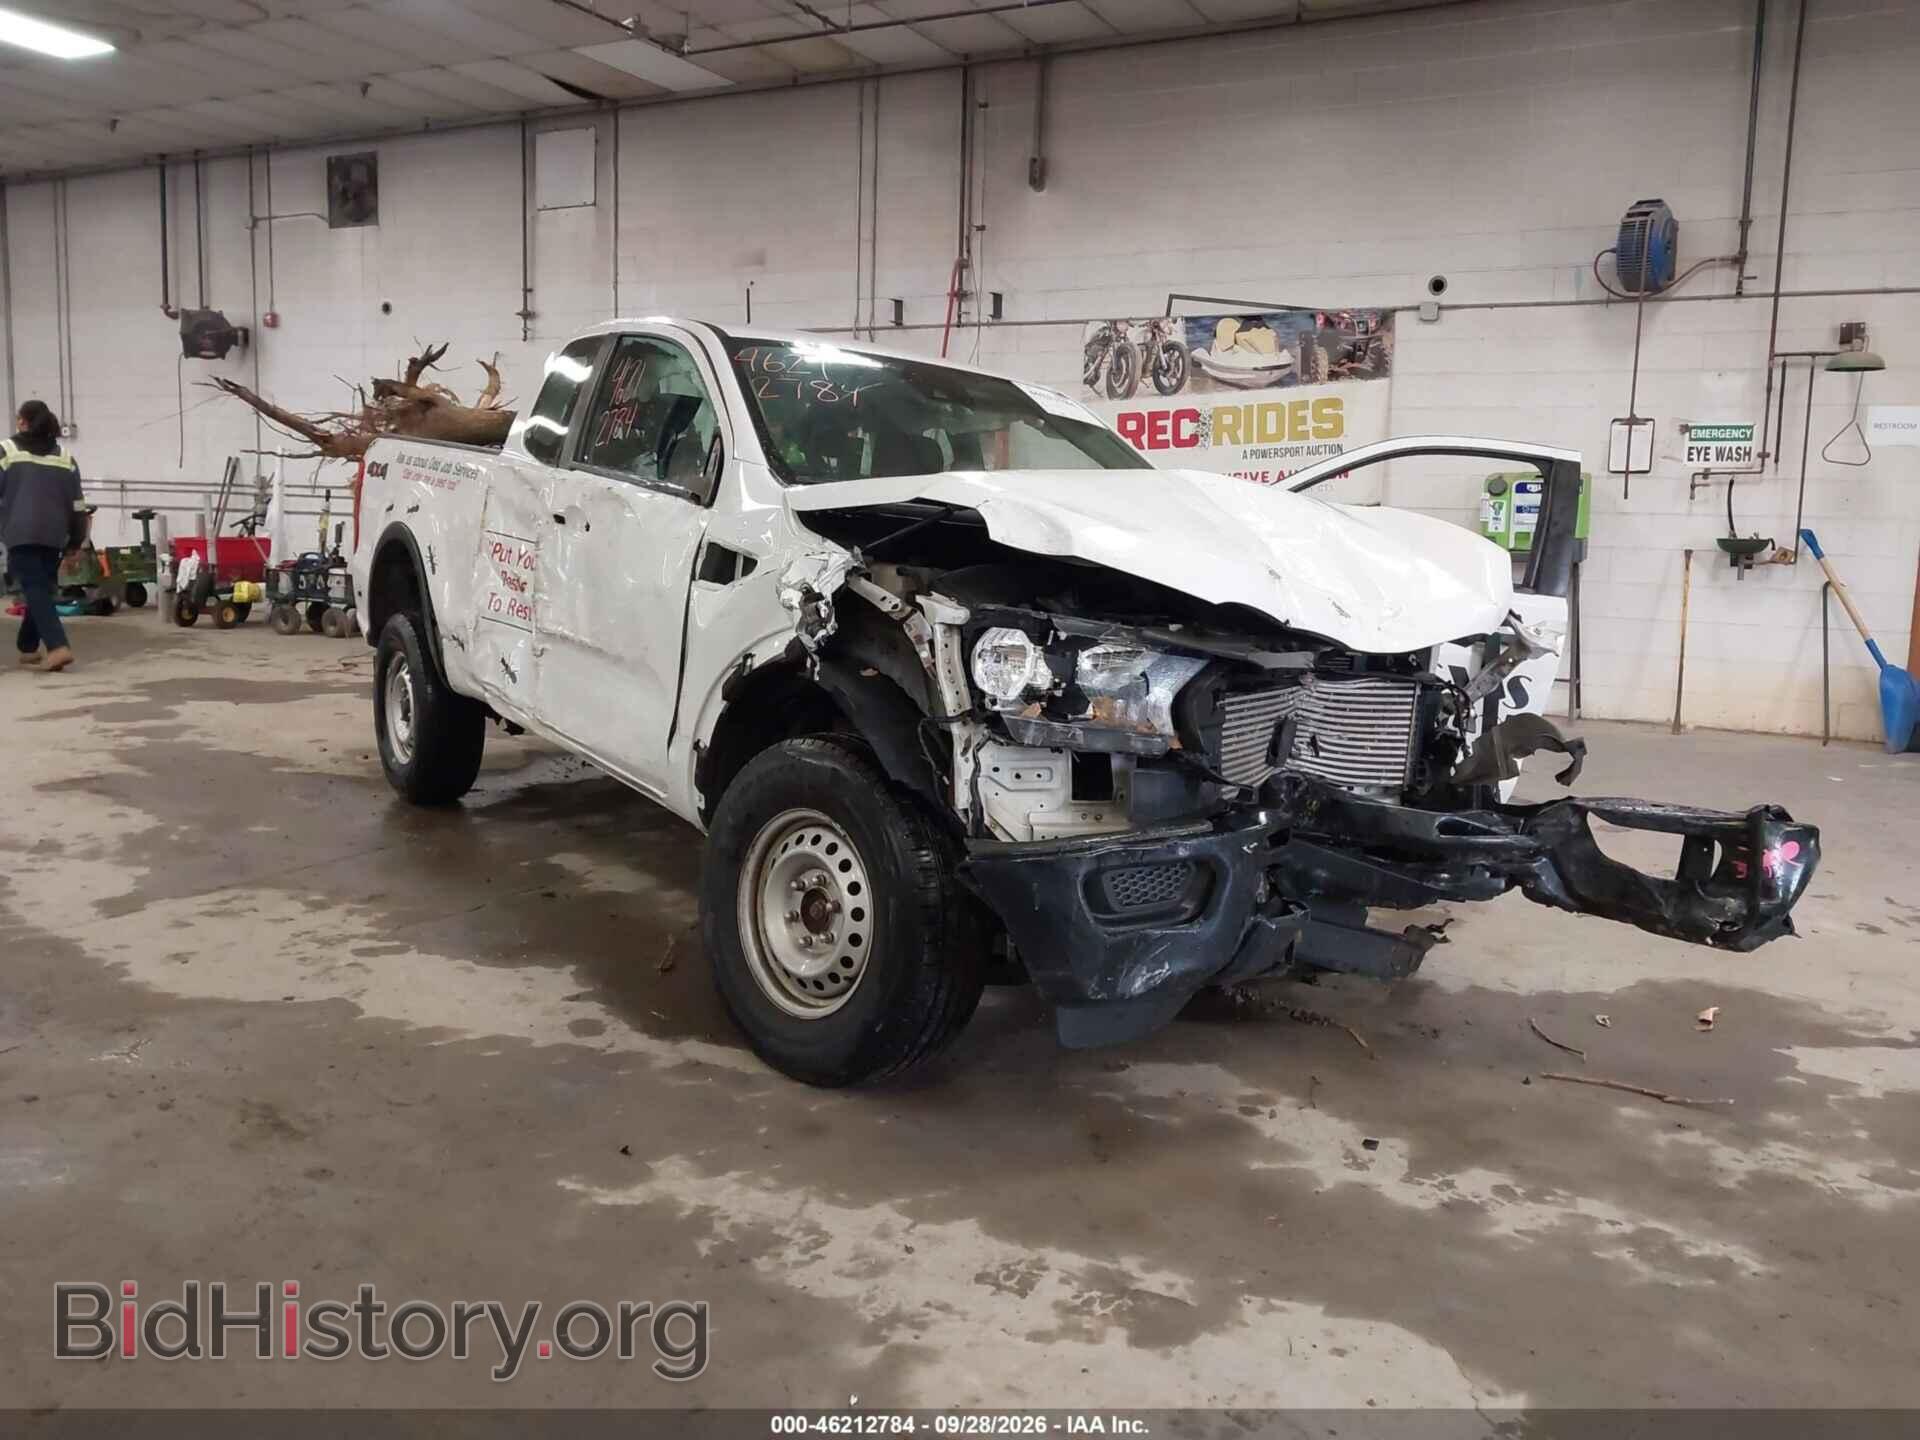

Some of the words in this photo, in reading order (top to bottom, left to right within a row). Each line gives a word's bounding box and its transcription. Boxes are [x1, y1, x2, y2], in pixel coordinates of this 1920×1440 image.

[1117, 408, 1199, 450] REC
[1212, 397, 1344, 446] RIDES
[1873, 422, 1917, 431] RESTROOM
[1690, 428, 1752, 439] EMERGENCY
[1242, 449, 1248, 460] A
[1250, 446, 1304, 460] POWERSPORT
[1306, 443, 1344, 456] AUCTION
[1687, 446, 1711, 462] EYE
[1715, 446, 1752, 462] WASH
[488, 592, 502, 612] To
